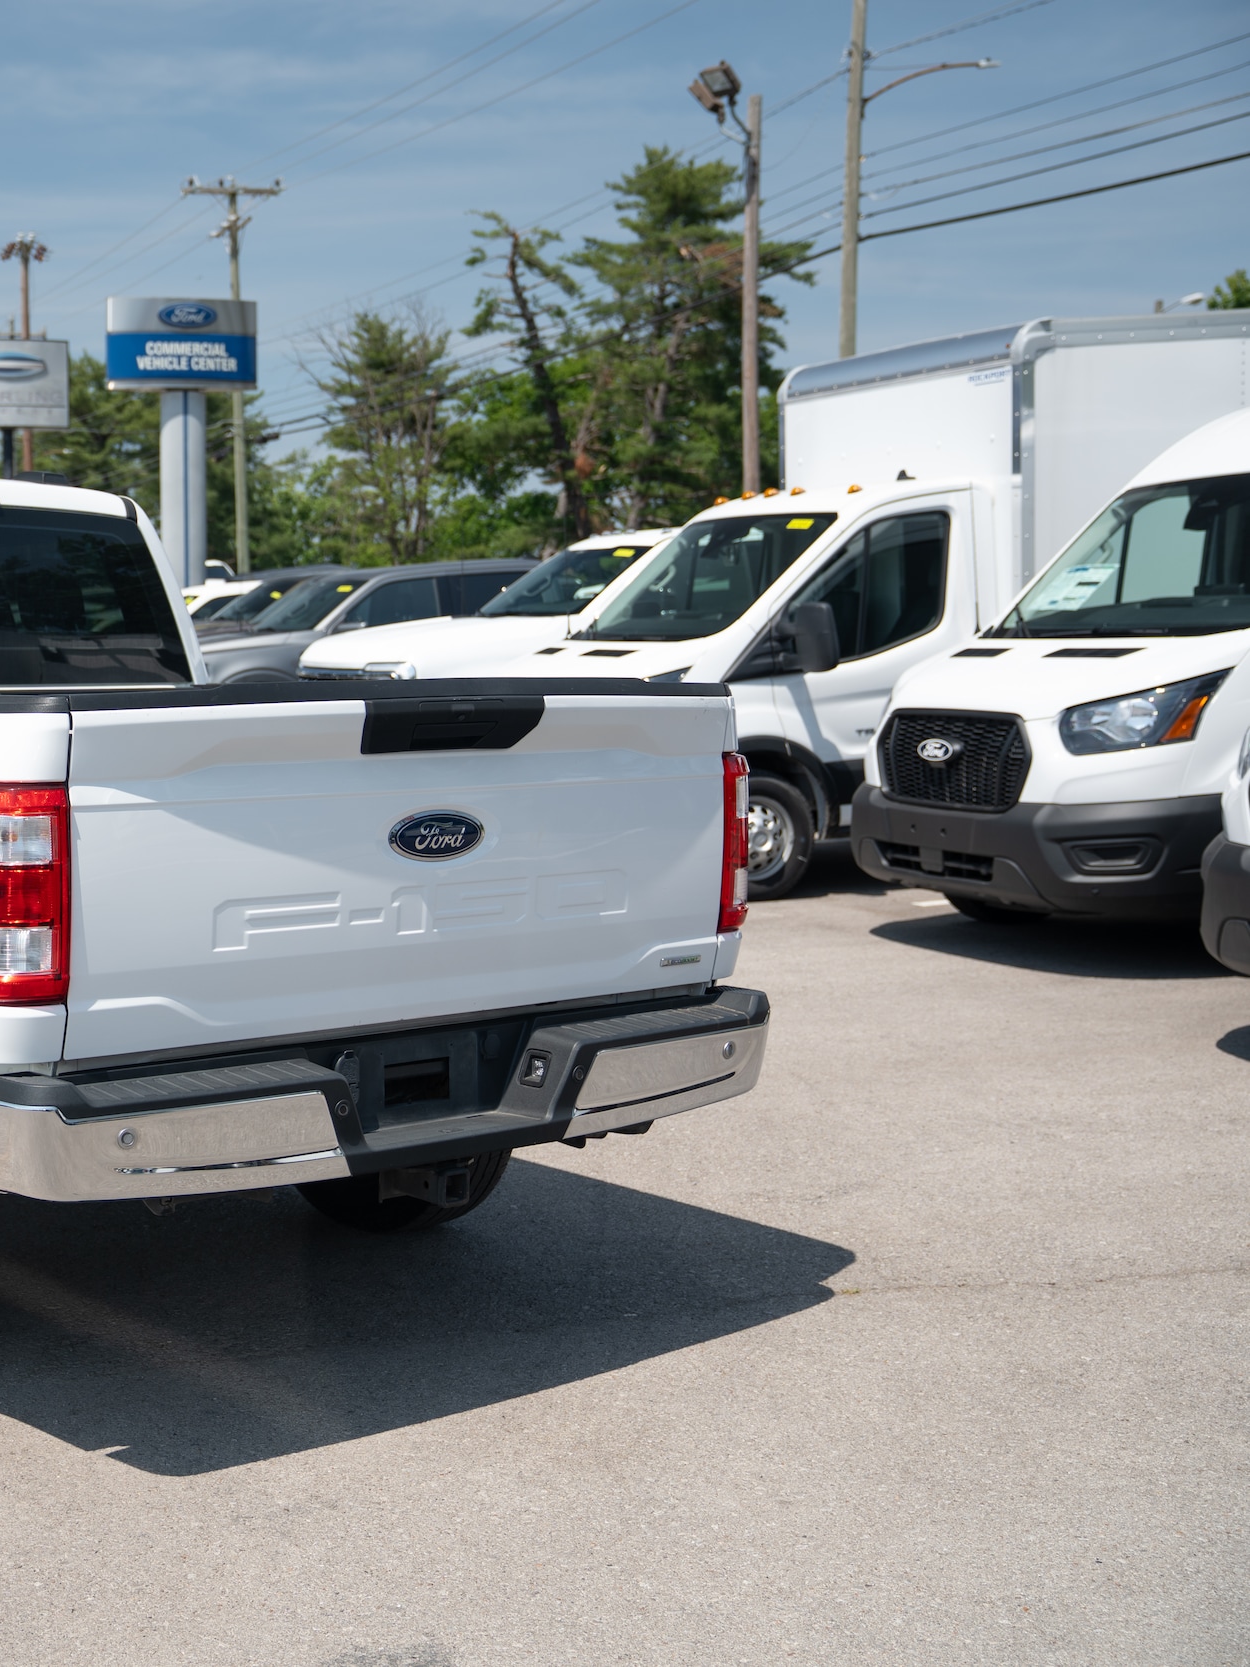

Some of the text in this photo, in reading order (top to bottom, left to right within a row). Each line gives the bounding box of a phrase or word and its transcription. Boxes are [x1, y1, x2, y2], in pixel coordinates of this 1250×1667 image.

[171, 307, 207, 323] Ford
[145, 341, 229, 358] COMMERCIAL
[136, 355, 238, 373] VEHICLE CENTER
[922, 742, 948, 758] Ford
[414, 821, 467, 850] Ford
[212, 868, 629, 952] F-150
